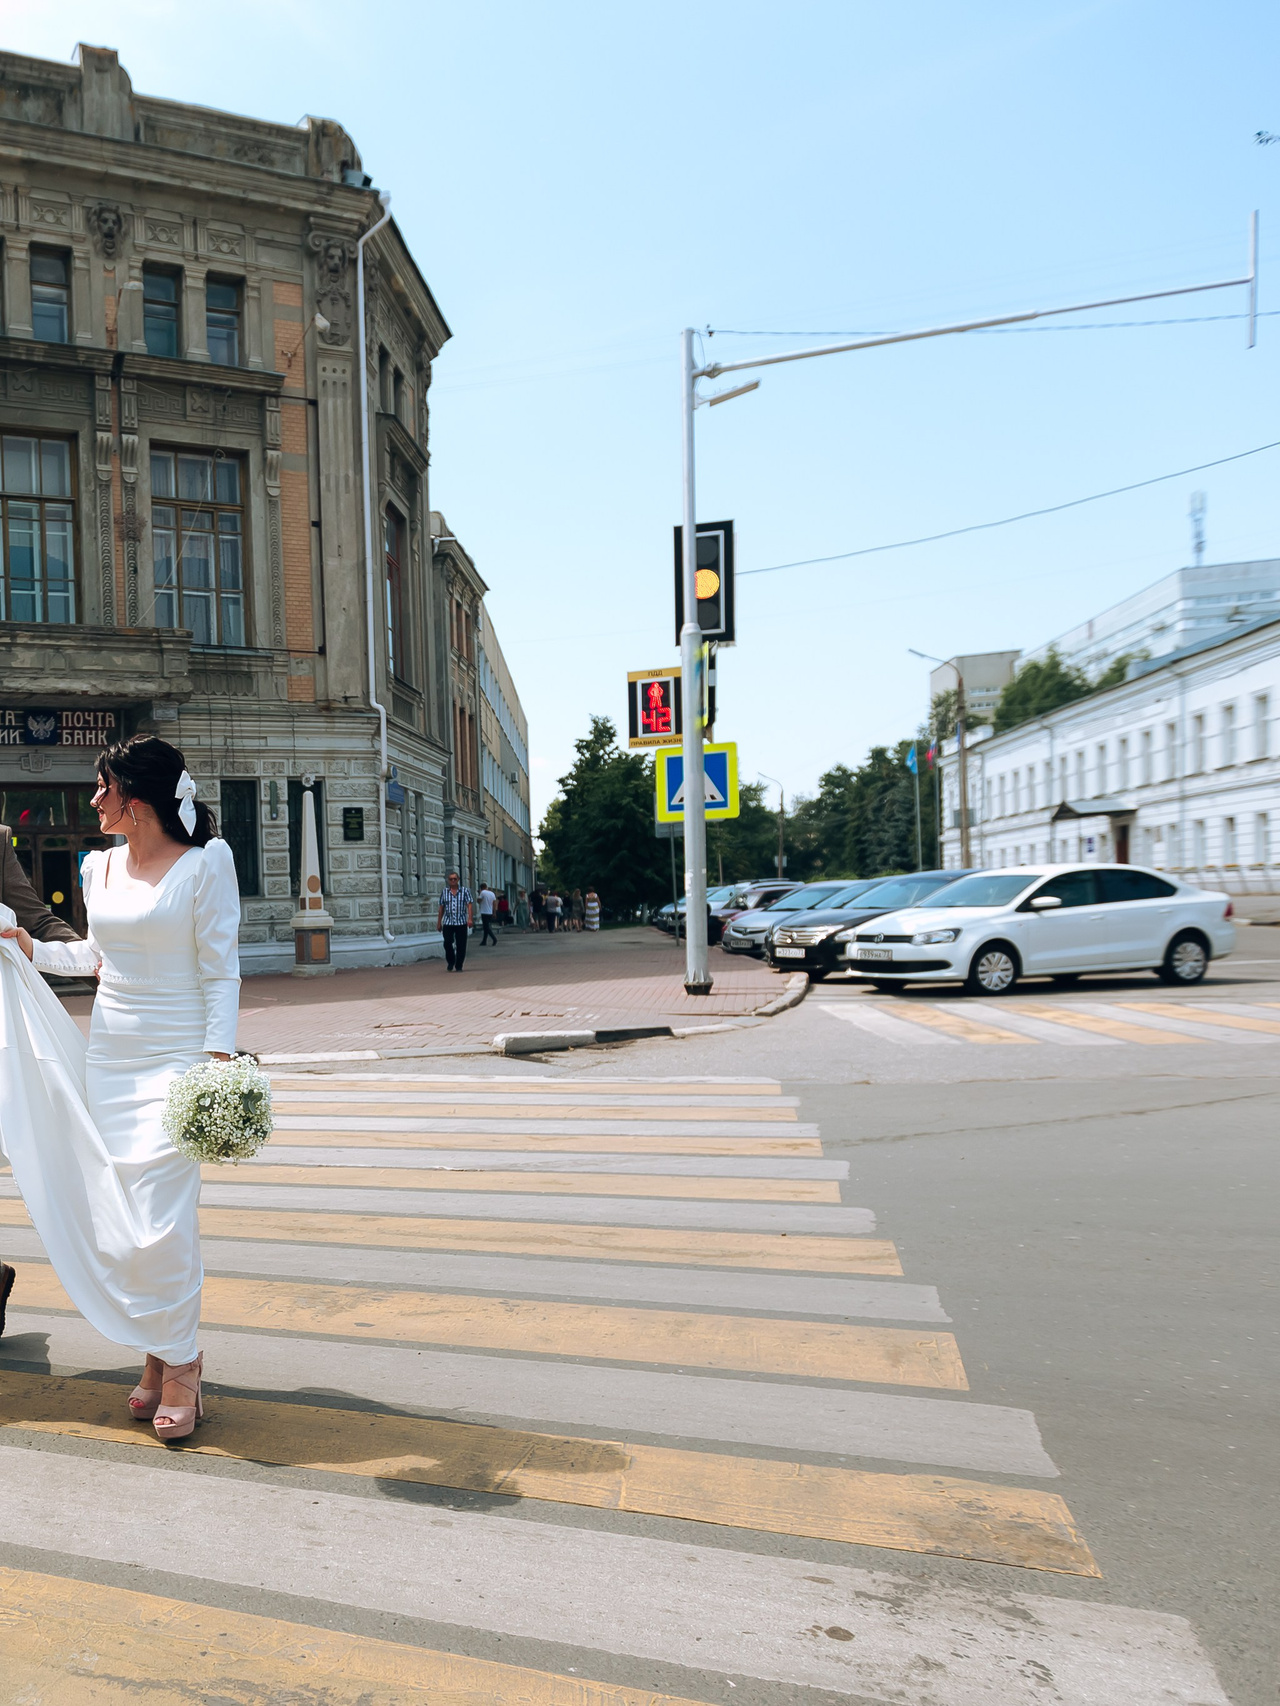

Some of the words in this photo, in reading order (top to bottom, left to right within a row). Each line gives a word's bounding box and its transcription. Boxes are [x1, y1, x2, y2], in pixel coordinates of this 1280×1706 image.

[62, 711, 115, 727] ПОЧТА
[641, 707, 671, 732] 42
[62, 729, 108, 745] БАНК
